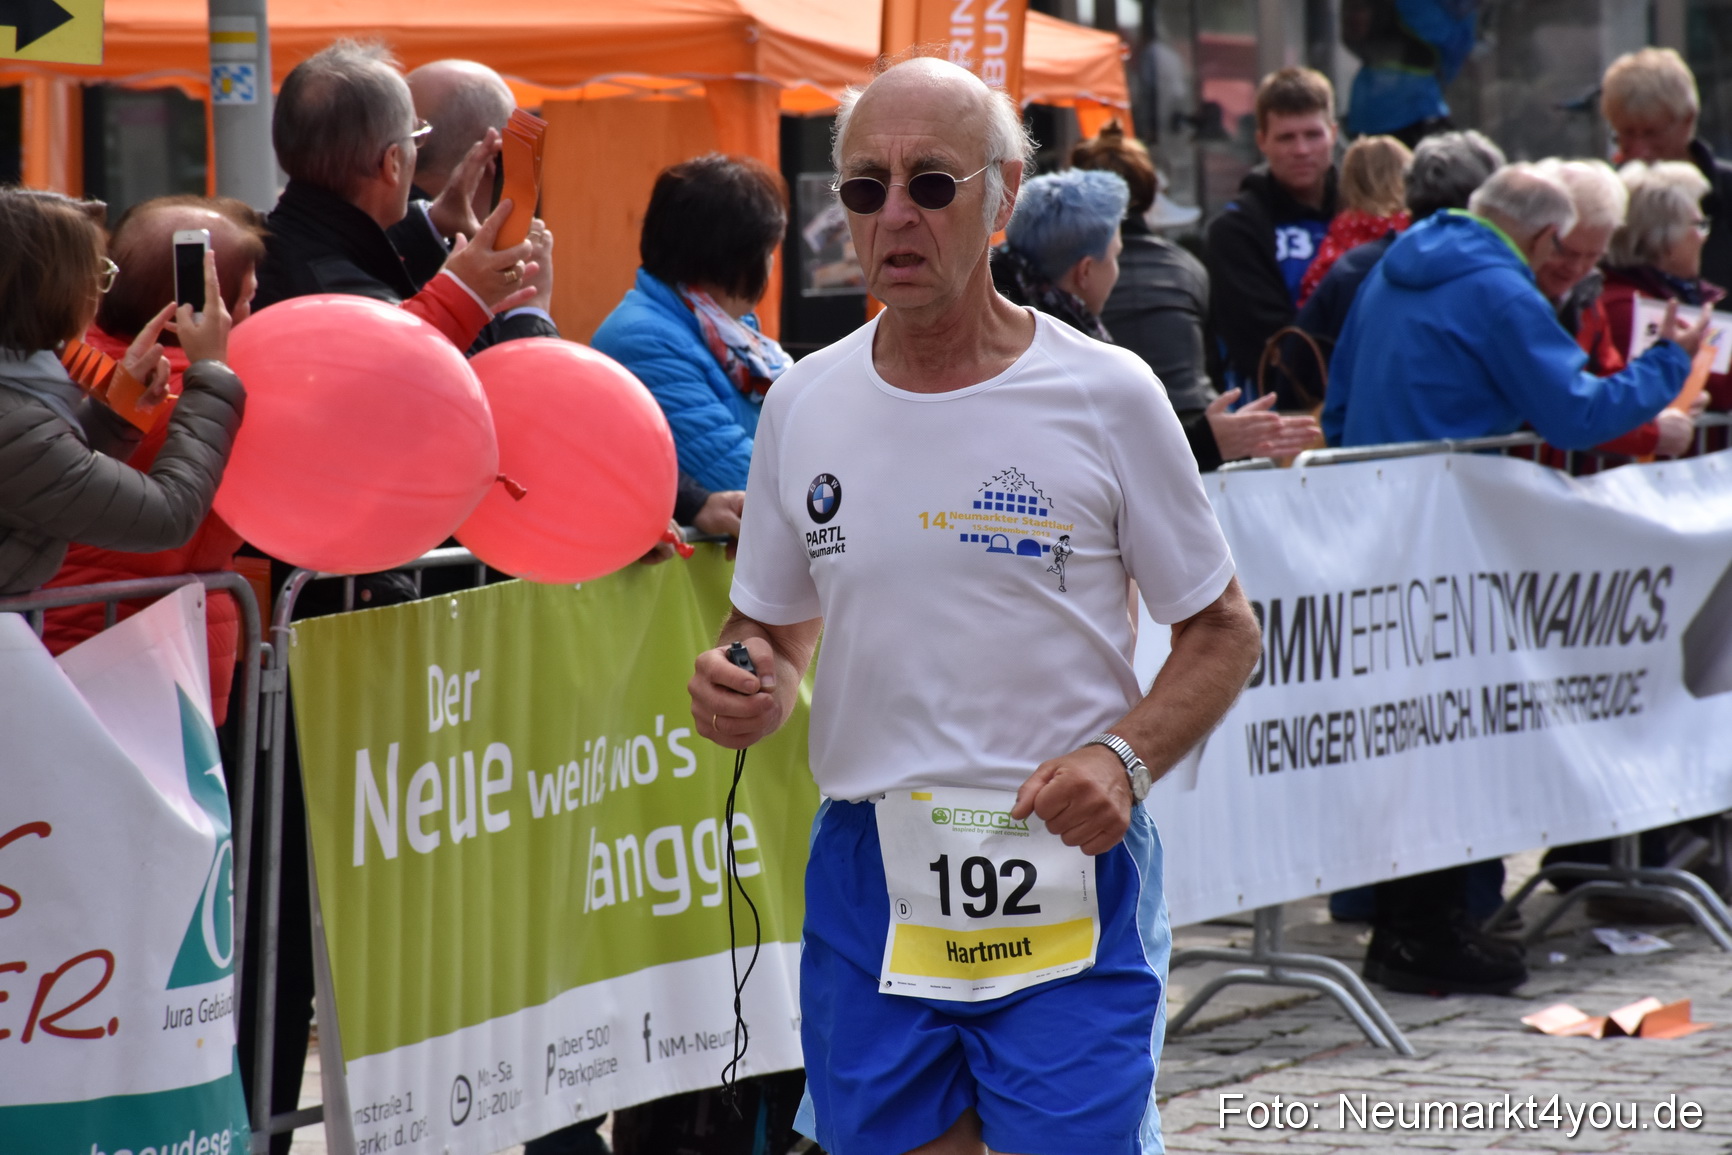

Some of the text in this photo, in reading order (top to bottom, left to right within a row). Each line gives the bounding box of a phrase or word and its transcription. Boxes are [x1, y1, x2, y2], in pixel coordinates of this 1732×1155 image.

[918, 511, 1075, 532] 14. Neumarkter Stadtlauf
[806, 526, 846, 548] PARTL
[808, 543, 846, 559] Neumarkt
[428, 663, 480, 733] Der
[1245, 709, 1357, 777] WENIGER
[352, 714, 697, 868] Neue weiß wo's
[929, 853, 1042, 919] 192
[900, 903, 908, 915] D
[946, 937, 1033, 965] Hartmut
[162, 1004, 193, 1031] Jura
[586, 1024, 610, 1050] 500
[405, 1090, 414, 1113] 1
